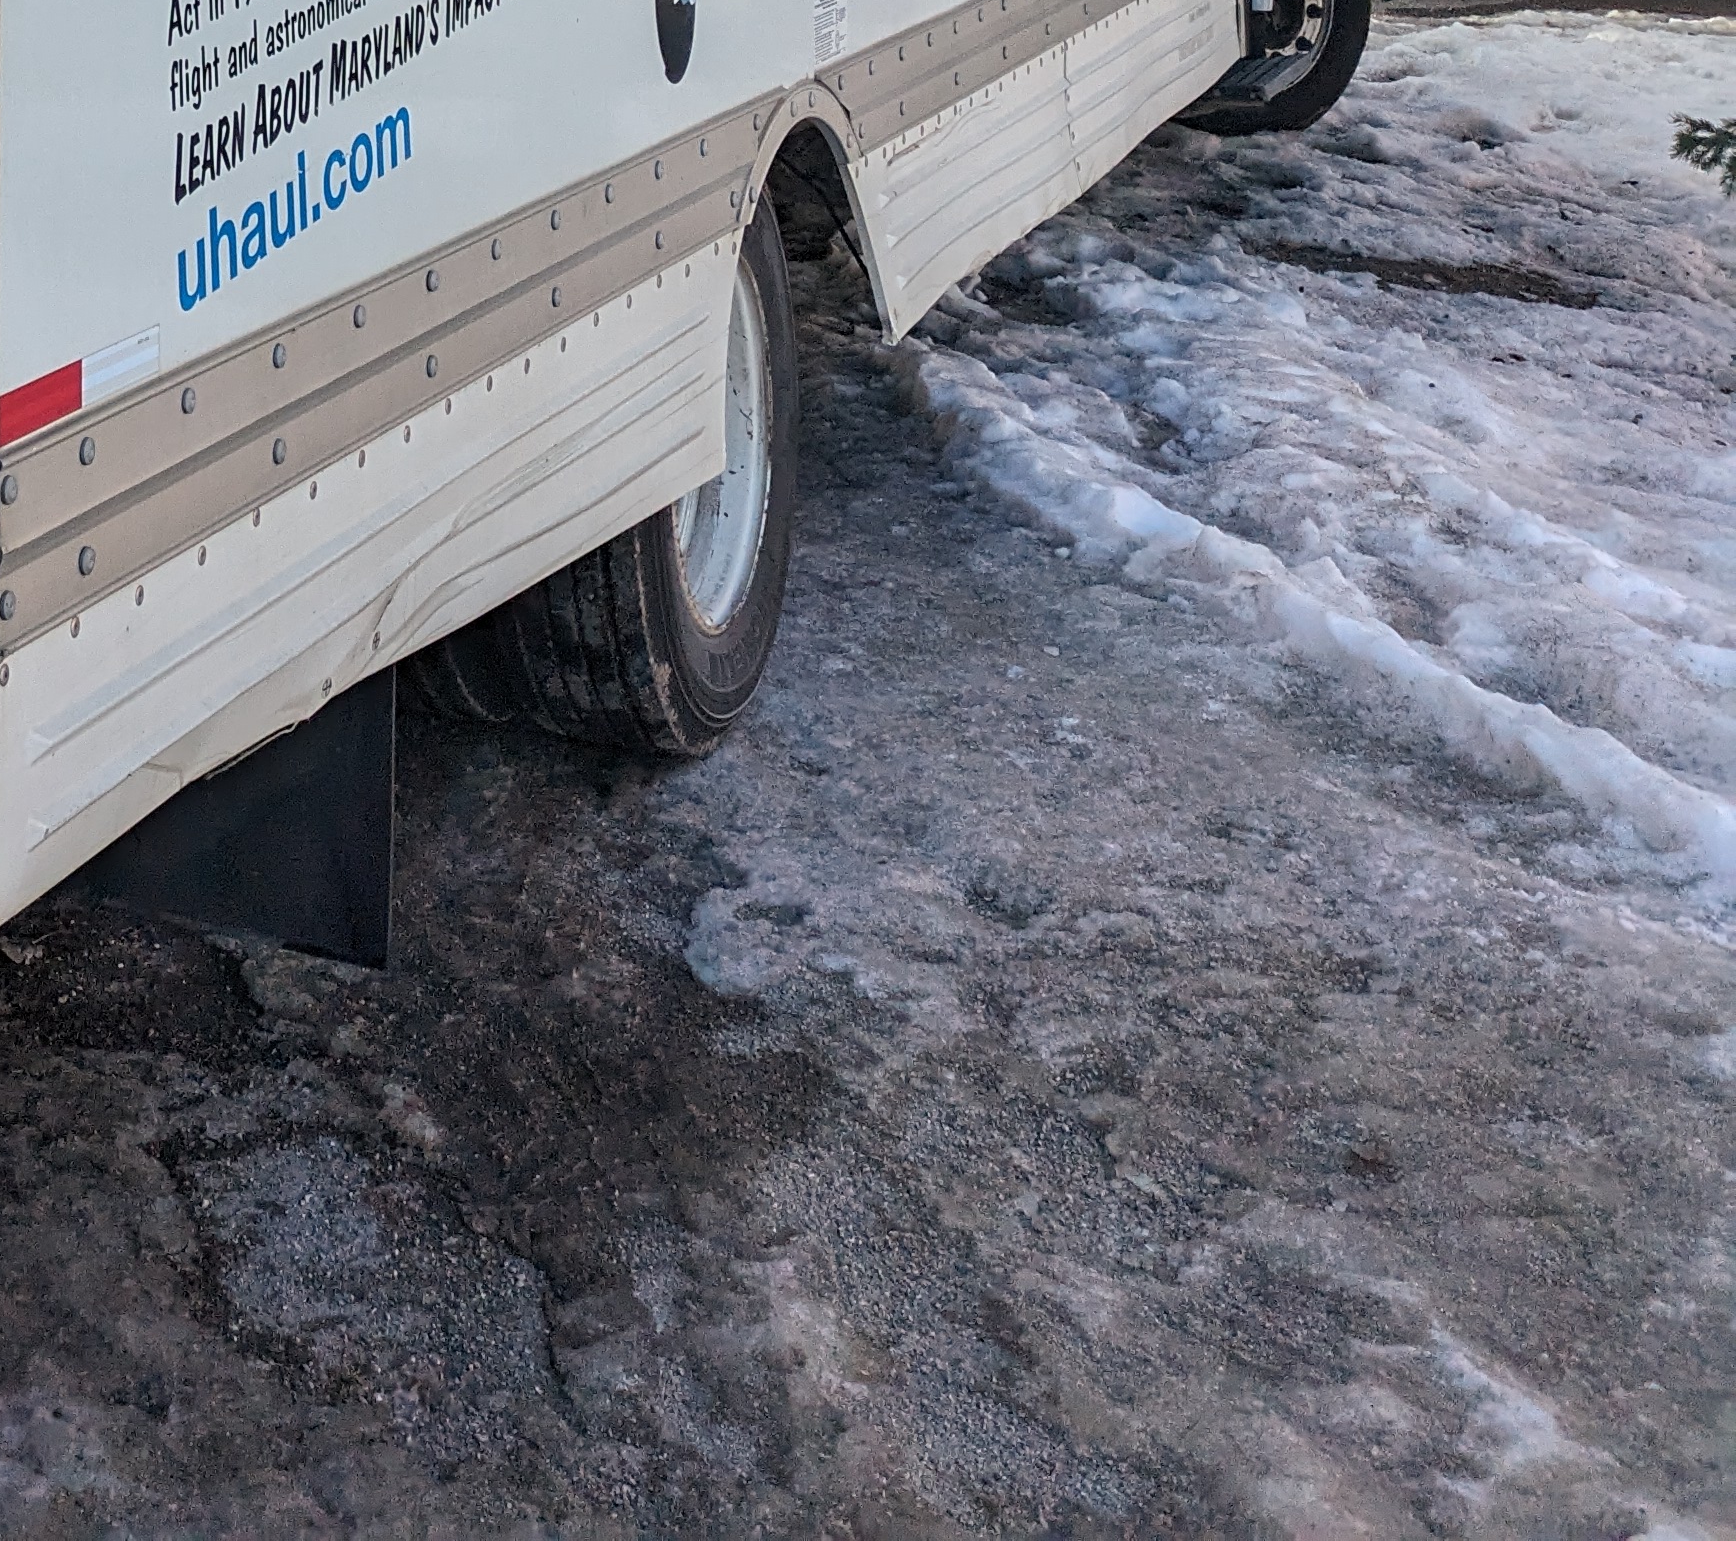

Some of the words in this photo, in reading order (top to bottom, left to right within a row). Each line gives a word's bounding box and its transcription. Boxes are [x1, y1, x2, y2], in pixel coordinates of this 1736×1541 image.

[170, 46, 219, 112] flight
[228, 21, 258, 76] and
[175, 103, 245, 205] LEARN
[253, 58, 323, 154] ABOUT
[177, 107, 412, 311] uhaul.com
